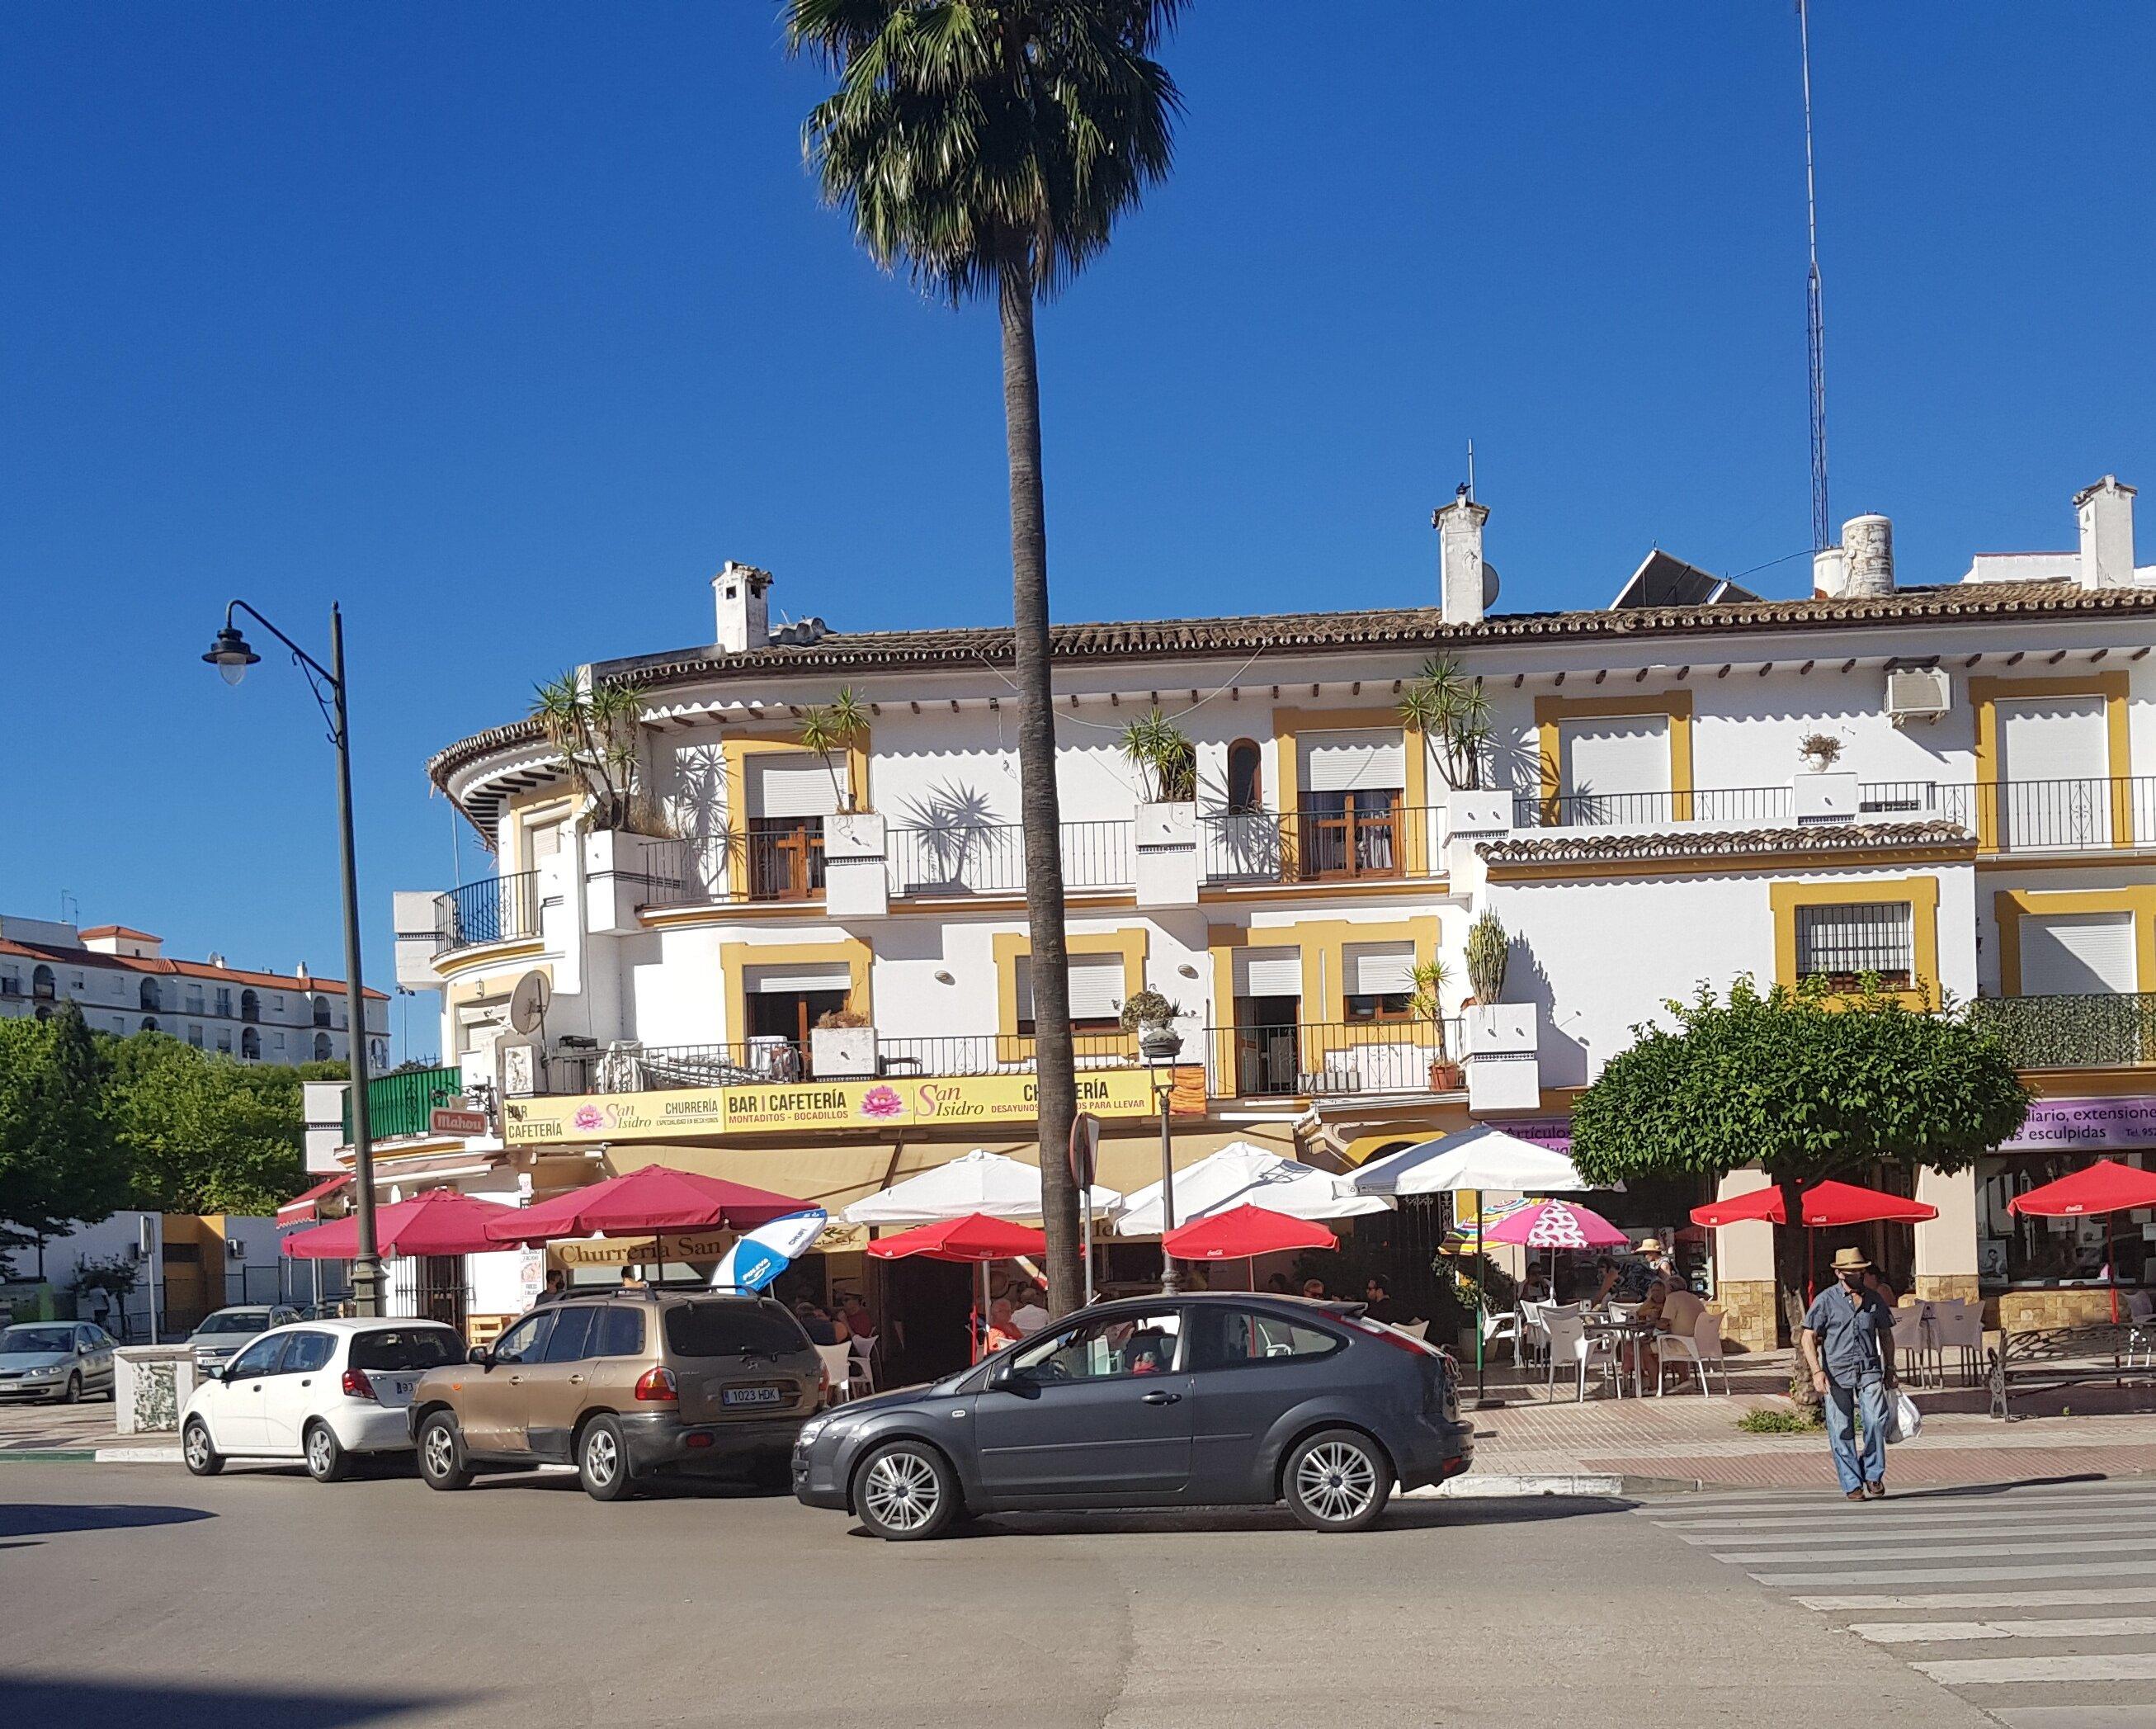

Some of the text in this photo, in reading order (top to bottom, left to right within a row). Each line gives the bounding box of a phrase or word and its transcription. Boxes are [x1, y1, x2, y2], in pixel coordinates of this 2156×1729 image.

[665, 1098, 719, 1114] CHURRERÍA
[729, 1089, 847, 1113] BAR CAFETERÍA
[915, 1084, 961, 1116] San
[991, 1104, 1039, 1113] DESAYUNOS
[1114, 1099, 1144, 1108] LLEVAR
[507, 1104, 528, 1118] BAR
[605, 1103, 635, 1129] San
[729, 1113, 786, 1123] MONTADITOS
[794, 1110, 848, 1120] BOCADILLOS
[936, 1101, 984, 1116] Isidro
[436, 1114, 482, 1130] Mahou
[508, 1120, 563, 1138] CAFETERÍA
[618, 1115, 651, 1129] Isidro
[2029, 1125, 2106, 1143] esculpidas
[678, 1237, 721, 1256] San
[734, 1389, 776, 1401] 1023 HDK
